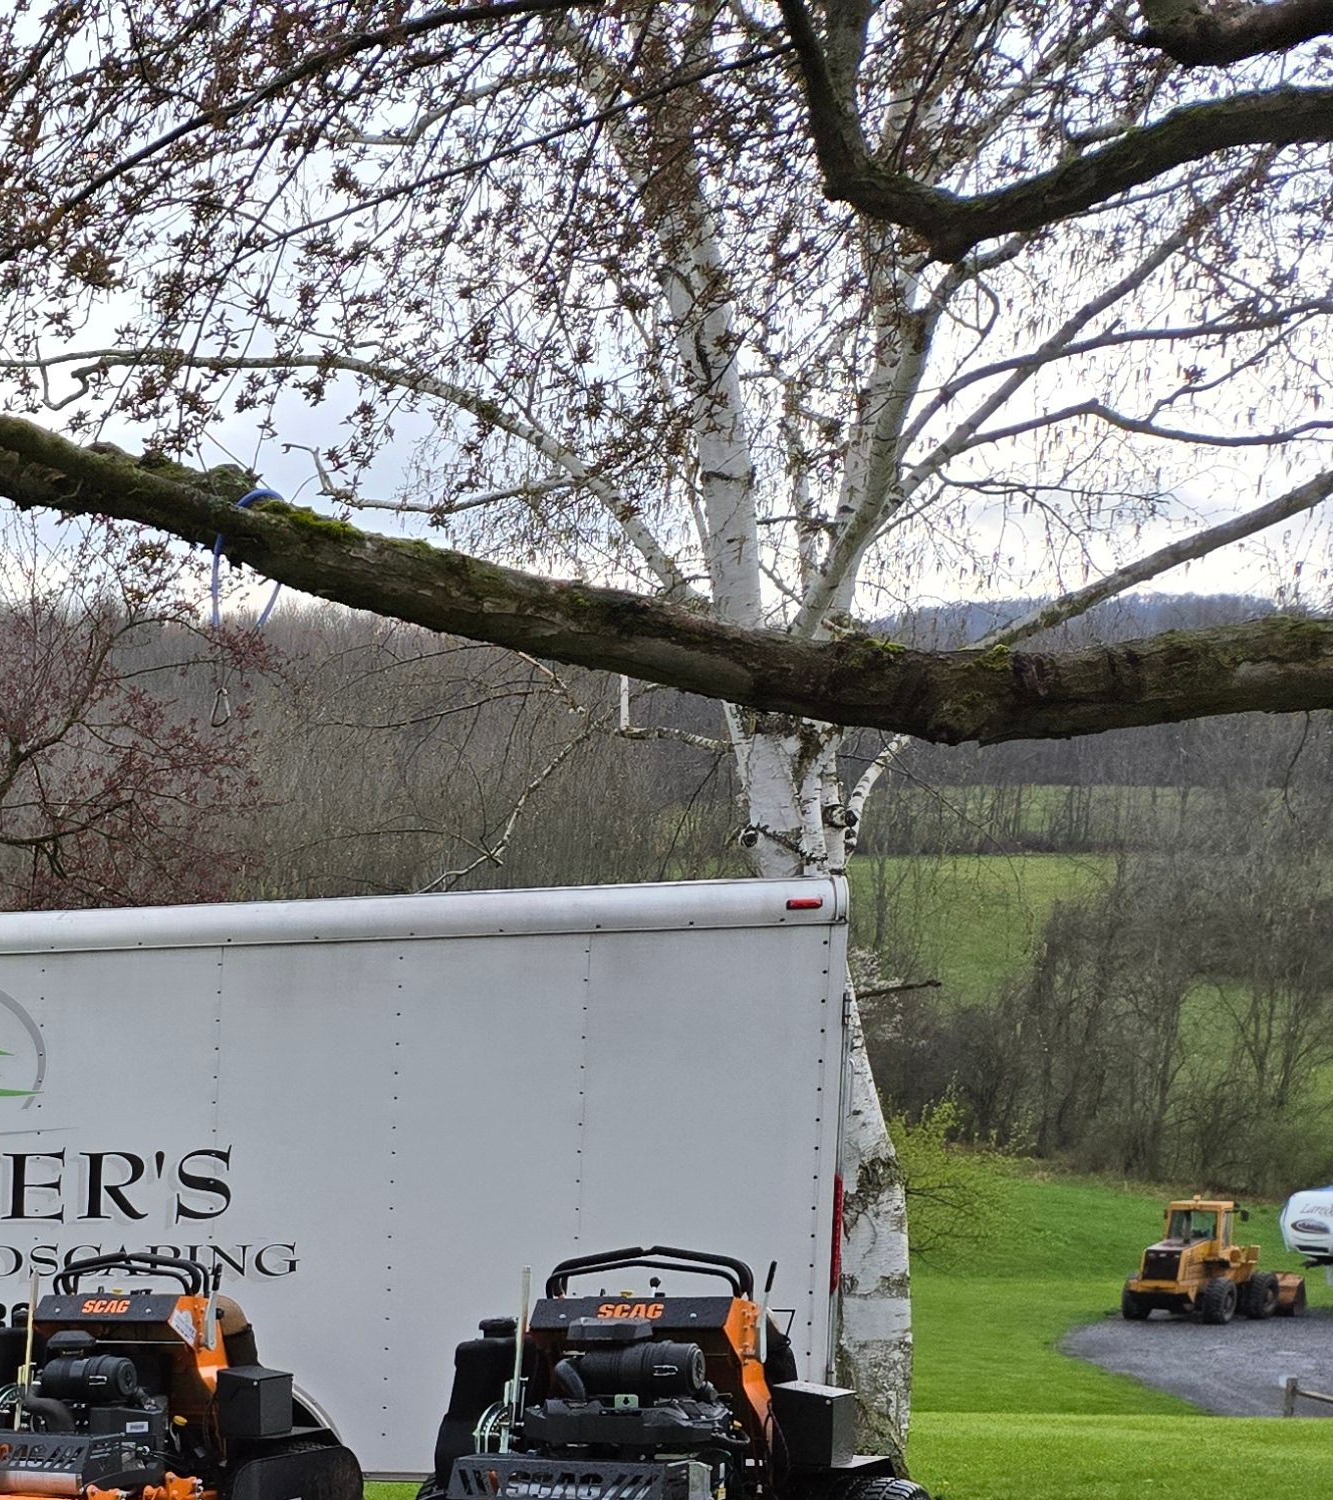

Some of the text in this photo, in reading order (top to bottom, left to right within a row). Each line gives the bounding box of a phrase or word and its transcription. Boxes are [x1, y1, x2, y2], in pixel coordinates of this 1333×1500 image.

[81, 1299, 131, 1315] SCAG
[597, 1303, 665, 1319] SCAG
[506, 1470, 604, 1500] SCAG
